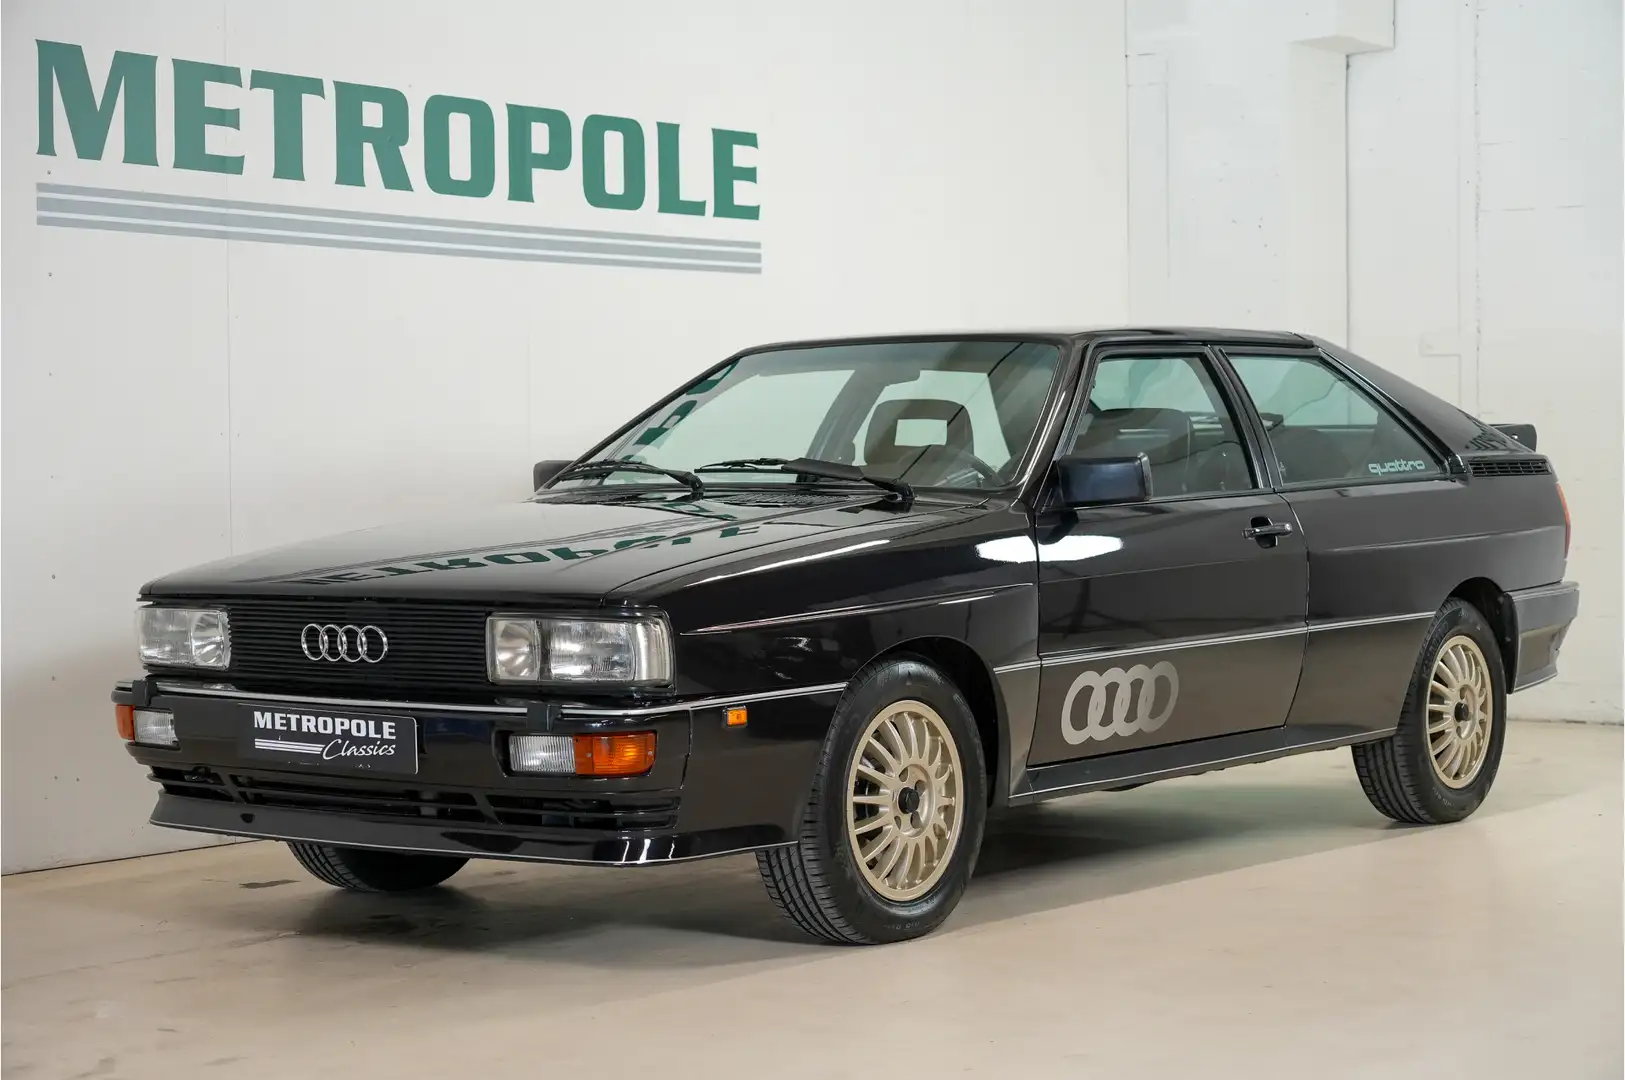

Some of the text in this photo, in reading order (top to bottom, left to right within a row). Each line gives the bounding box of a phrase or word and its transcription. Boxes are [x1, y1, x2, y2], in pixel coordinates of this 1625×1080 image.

[35, 39, 761, 221] METROPOLE
[1368, 459, 1426, 476] quattro
[253, 711, 397, 740] METROPOLE
[322, 738, 396, 760] Classics
